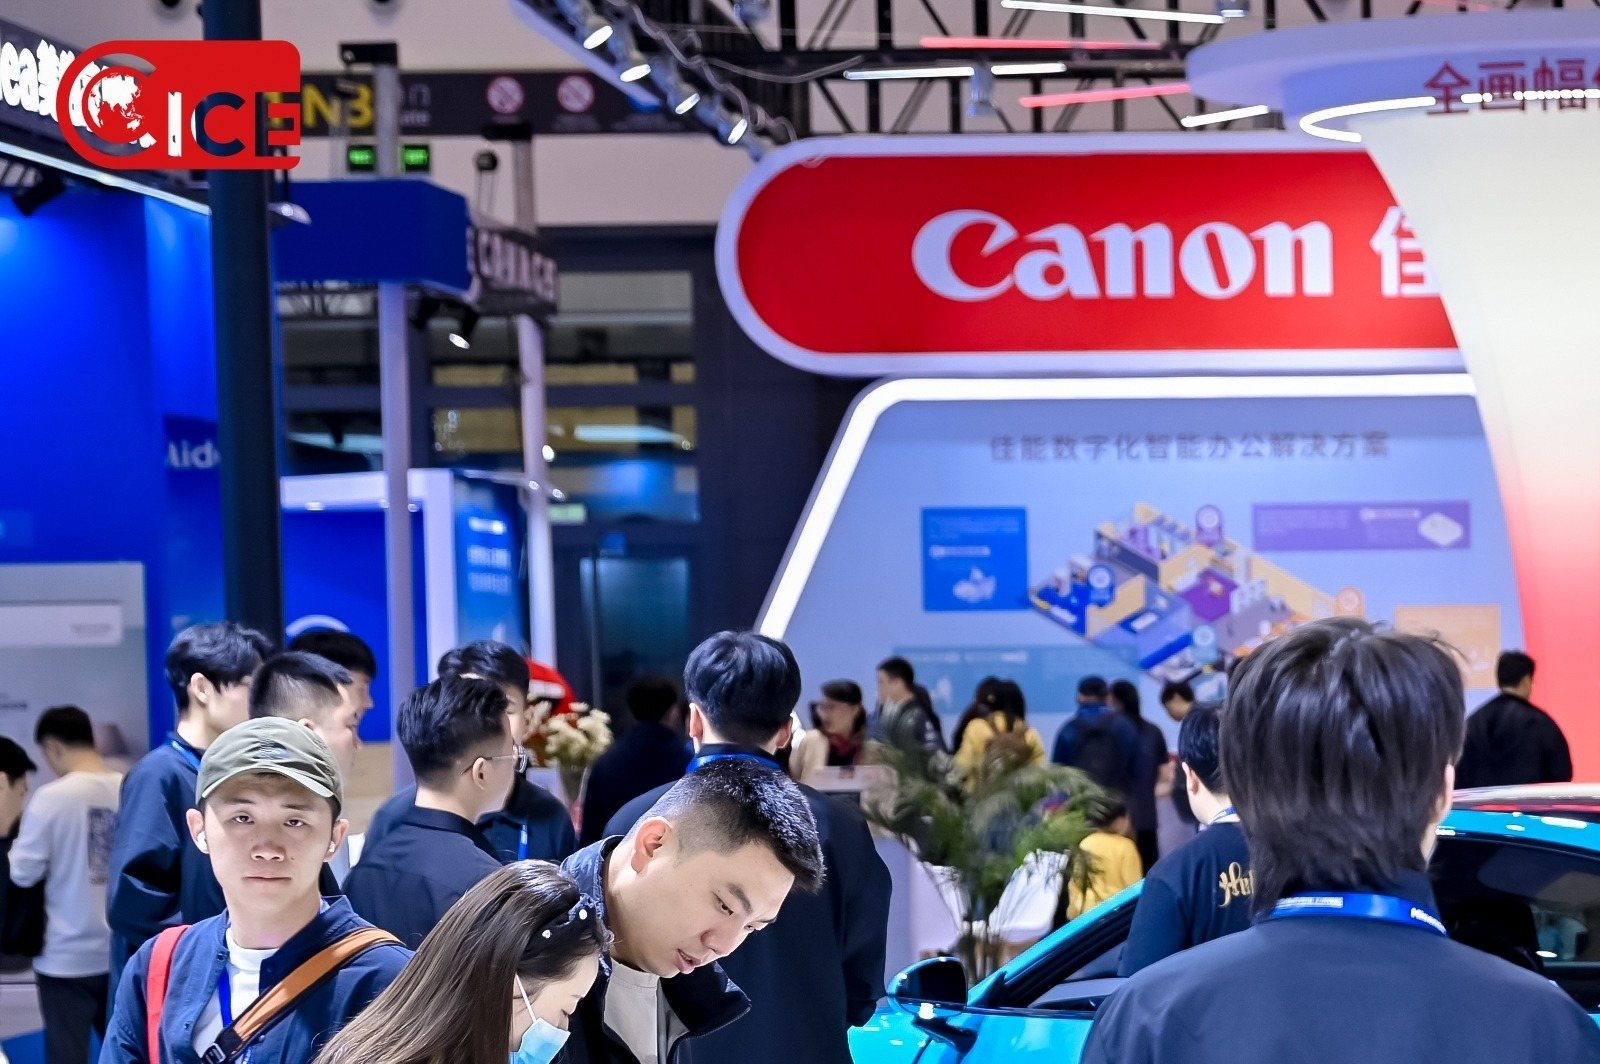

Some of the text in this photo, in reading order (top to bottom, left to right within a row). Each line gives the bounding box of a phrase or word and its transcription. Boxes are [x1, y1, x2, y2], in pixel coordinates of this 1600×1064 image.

[912, 208, 1334, 301] Canon
[988, 431, 1392, 463] 佳能数字化智能办公解决方案
